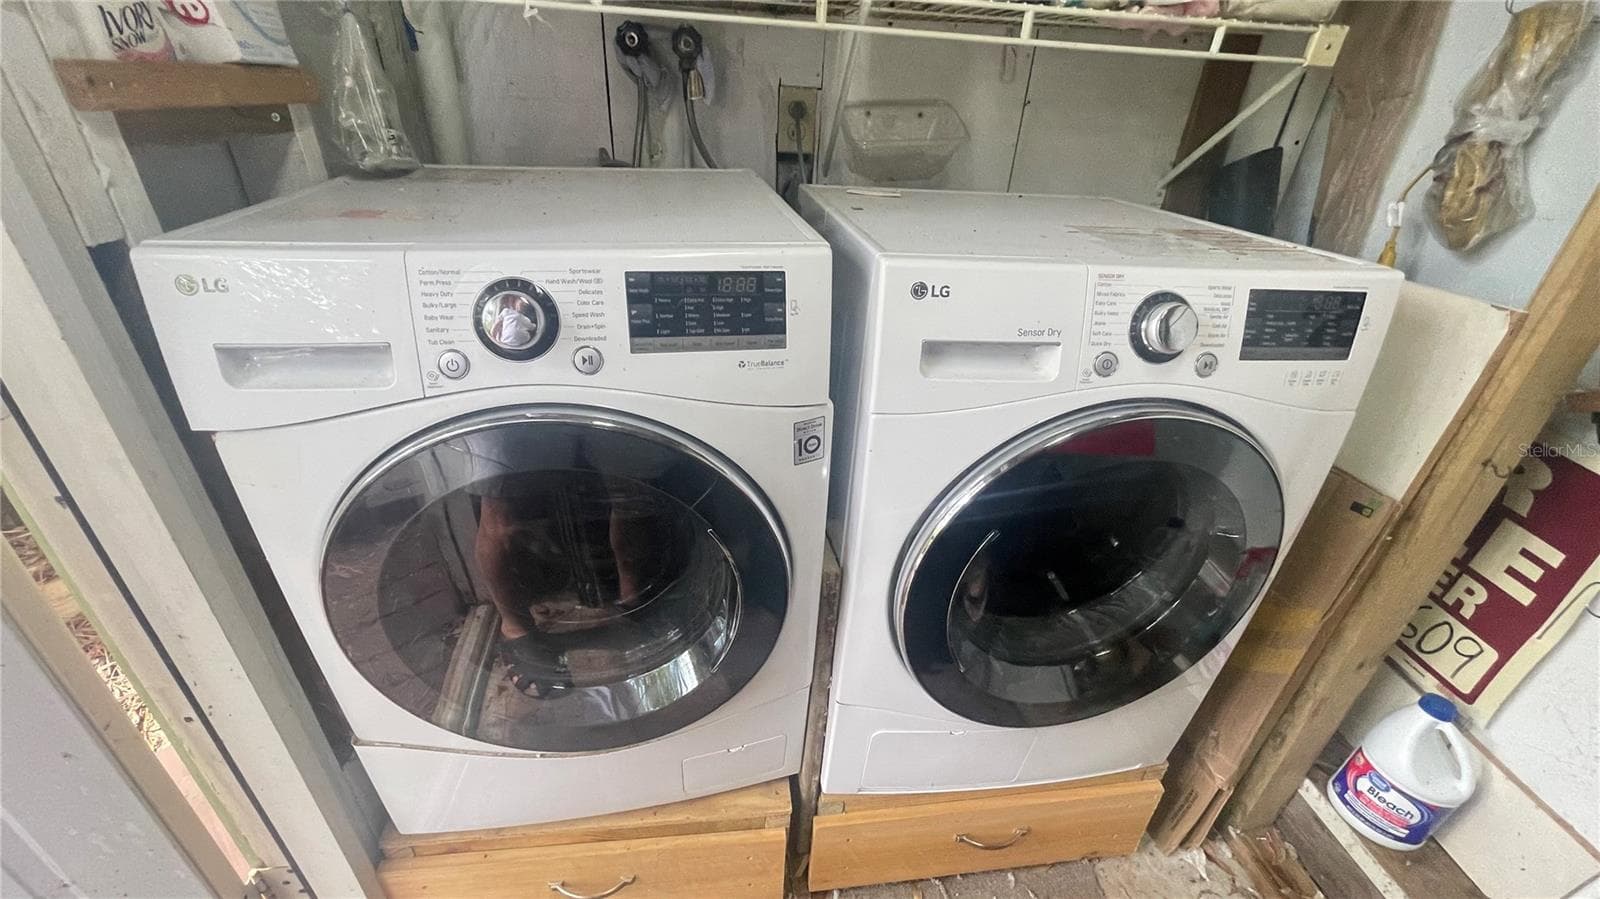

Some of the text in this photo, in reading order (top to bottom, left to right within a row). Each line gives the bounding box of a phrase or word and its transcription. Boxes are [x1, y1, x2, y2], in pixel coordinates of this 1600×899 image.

[111, 33, 147, 50] SNOW
[202, 278, 229, 293] LG
[931, 285, 950, 298] LG
[1018, 328, 1062, 338] Sensor Dry
[797, 435, 821, 457] 10
[1366, 786, 1415, 820] Bleach
